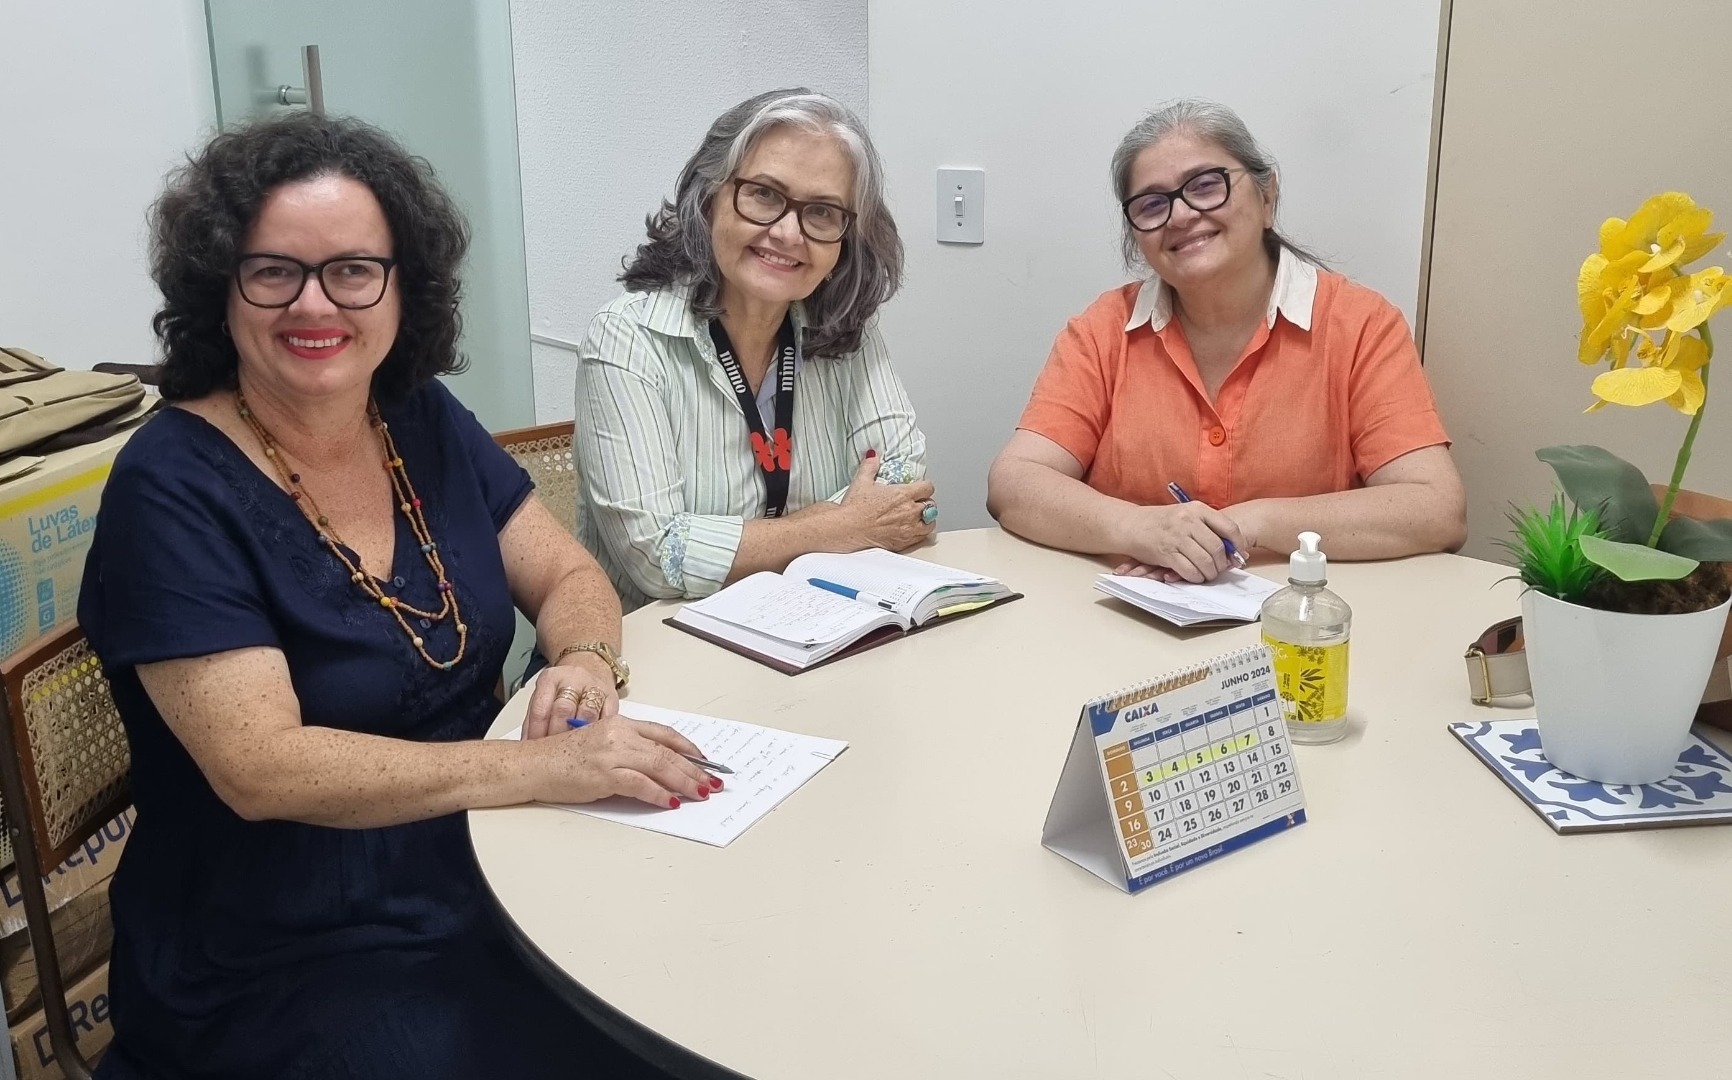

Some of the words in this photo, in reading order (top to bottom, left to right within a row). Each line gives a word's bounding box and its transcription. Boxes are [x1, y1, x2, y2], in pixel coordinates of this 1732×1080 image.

[719, 350, 747, 394] mimo
[779, 346, 795, 392] mimo
[28, 505, 78, 536] Luvas
[31, 532, 52, 553] de
[1221, 672, 1250, 690] JUNHO
[1250, 665, 1271, 680] 2024
[1124, 702, 1159, 723] CAIXA
[1264, 706, 1269, 717] 1
[1120, 780, 1129, 793] 2
[1146, 771, 1154, 782] 3
[1171, 761, 1178, 772] 4
[1196, 752, 1203, 764] 5
[1220, 743, 1227, 755] 6
[1244, 734, 1250, 746] 7
[1268, 725, 1275, 737] 8
[1124, 800, 1133, 812] 9
[1148, 789, 1161, 803] 10
[1174, 780, 1185, 793] 11
[1199, 770, 1211, 783] 12
[1223, 761, 1235, 774] 13
[1247, 752, 1258, 765] 14
[1270, 743, 1281, 756] 15
[1126, 838, 1138, 850] 23
[1140, 839, 1152, 850] 30
[1158, 827, 1172, 842] 24
[1183, 817, 1198, 832] 25
[1208, 808, 1222, 822] 26
[1232, 798, 1244, 813] 27
[1255, 789, 1269, 803] 28
[1278, 780, 1291, 794] 29
[1127, 819, 1141, 832] 16
[1153, 808, 1165, 822] 17
[1179, 799, 1192, 812] 18
[1204, 789, 1216, 802] 19
[1227, 780, 1241, 794] 20
[1251, 771, 1263, 784] 21
[1273, 761, 1287, 775] 22
[1144, 874, 1154, 885] por
[1154, 868, 1169, 879] você.
[1175, 861, 1185, 872] por
[1186, 858, 1194, 867] um
[1194, 853, 1209, 863] novo
